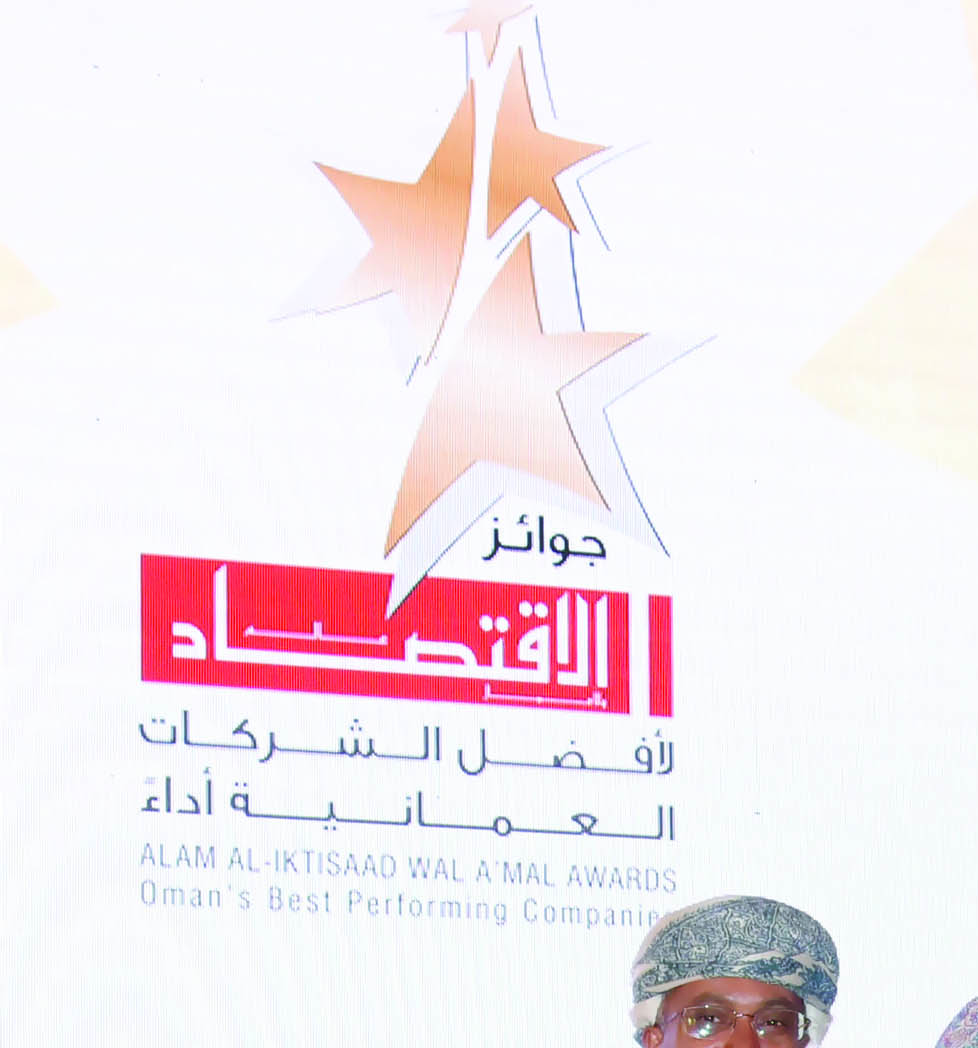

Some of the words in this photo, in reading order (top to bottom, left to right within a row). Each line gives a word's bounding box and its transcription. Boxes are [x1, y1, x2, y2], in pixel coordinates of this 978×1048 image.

[482, 514, 607, 566] جوائز
[138, 710, 440, 763] الشركات
[458, 727, 674, 775] لأفضل
[230, 782, 675, 841] العمانية
[141, 843, 216, 871] ALAM
[227, 847, 397, 878] AL-IKTISAAD
[408, 857, 465, 882] WAL
[566, 866, 678, 892] AWARDS
[141, 880, 251, 910] Oman's
[269, 887, 332, 913] Best
[348, 890, 507, 925] Performing
